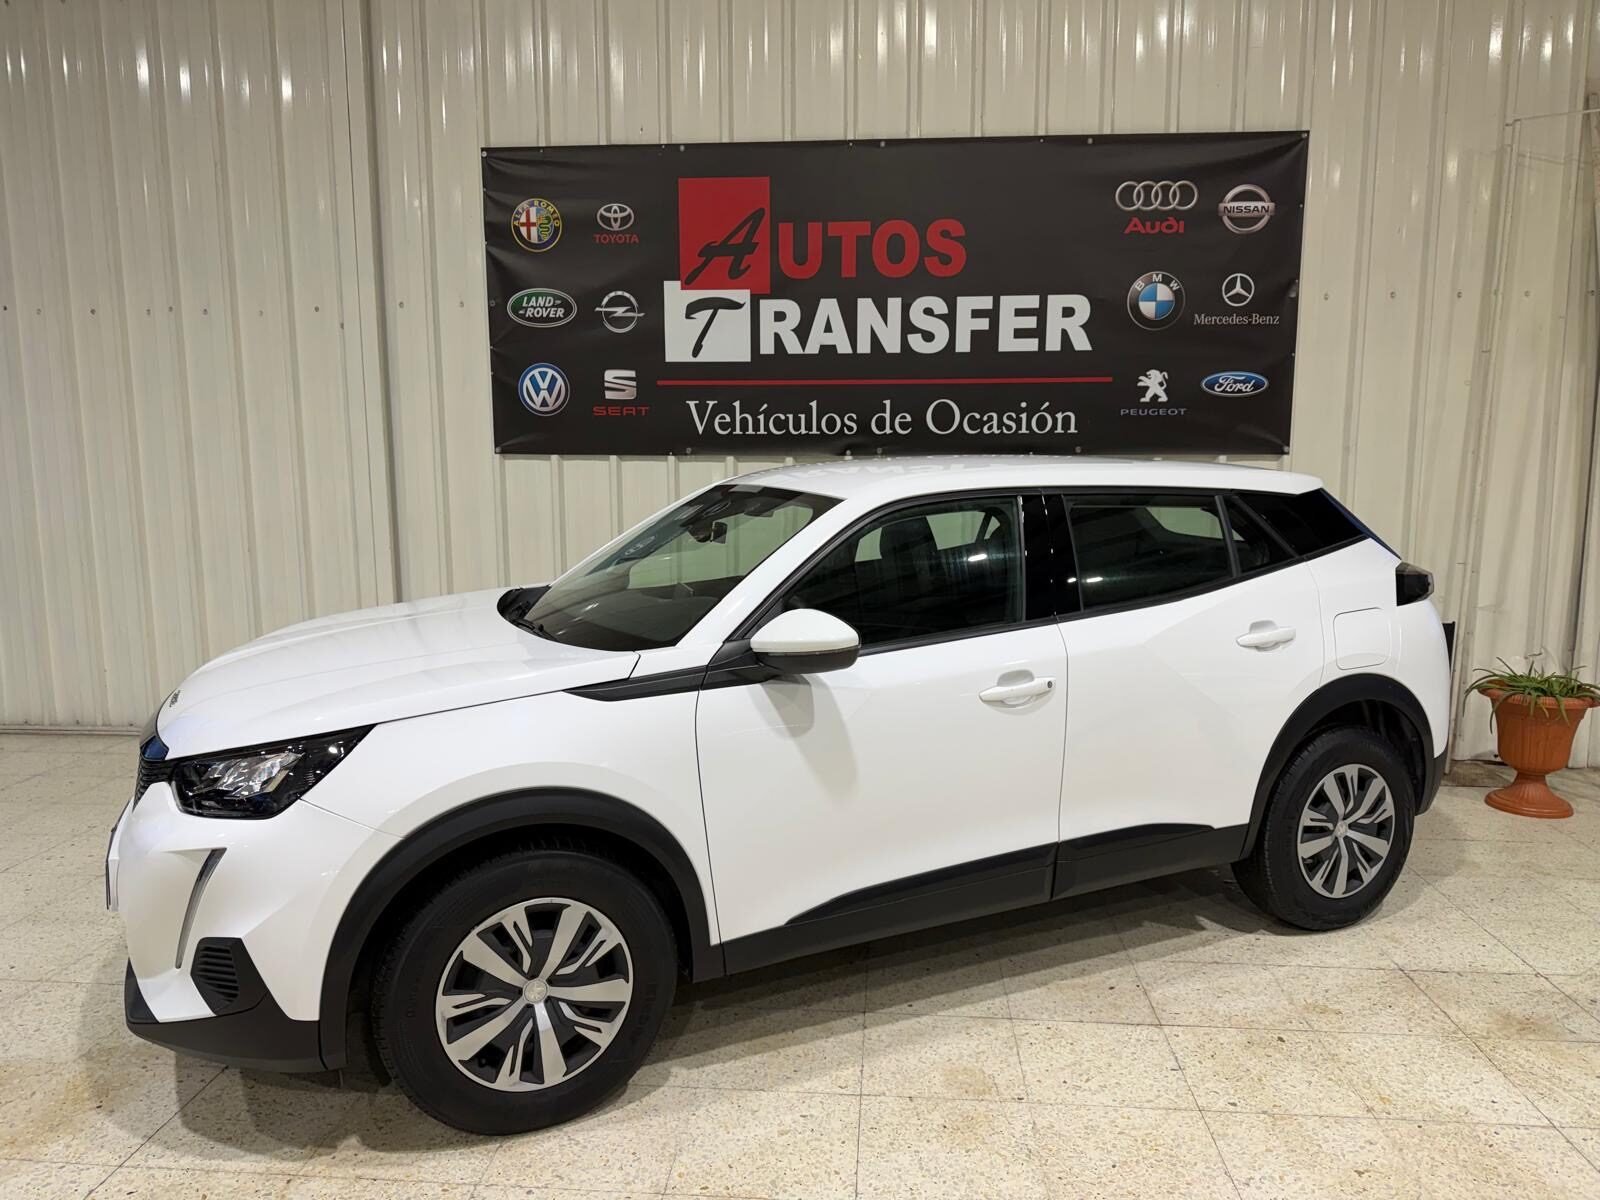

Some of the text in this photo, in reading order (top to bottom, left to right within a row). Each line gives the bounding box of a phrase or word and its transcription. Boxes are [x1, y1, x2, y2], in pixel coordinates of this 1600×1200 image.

[513, 200, 561, 227] ALFA ROMEO
[1223, 205, 1270, 215] NISSAN
[1124, 217, 1185, 235] Audi
[593, 233, 640, 245] TOYOTA
[684, 207, 967, 286] AUTOS
[1135, 273, 1181, 292] BMW
[522, 296, 554, 308] LAND
[525, 307, 565, 319] ROVER
[1193, 313, 1280, 326] Mercedes-Benz
[684, 295, 1093, 359] TRANSFER
[1214, 375, 1256, 393] Ford
[592, 405, 650, 417] SEAT
[686, 398, 1078, 435] Vehículos de Ocasión
[1120, 407, 1188, 417] PEUGEOT
